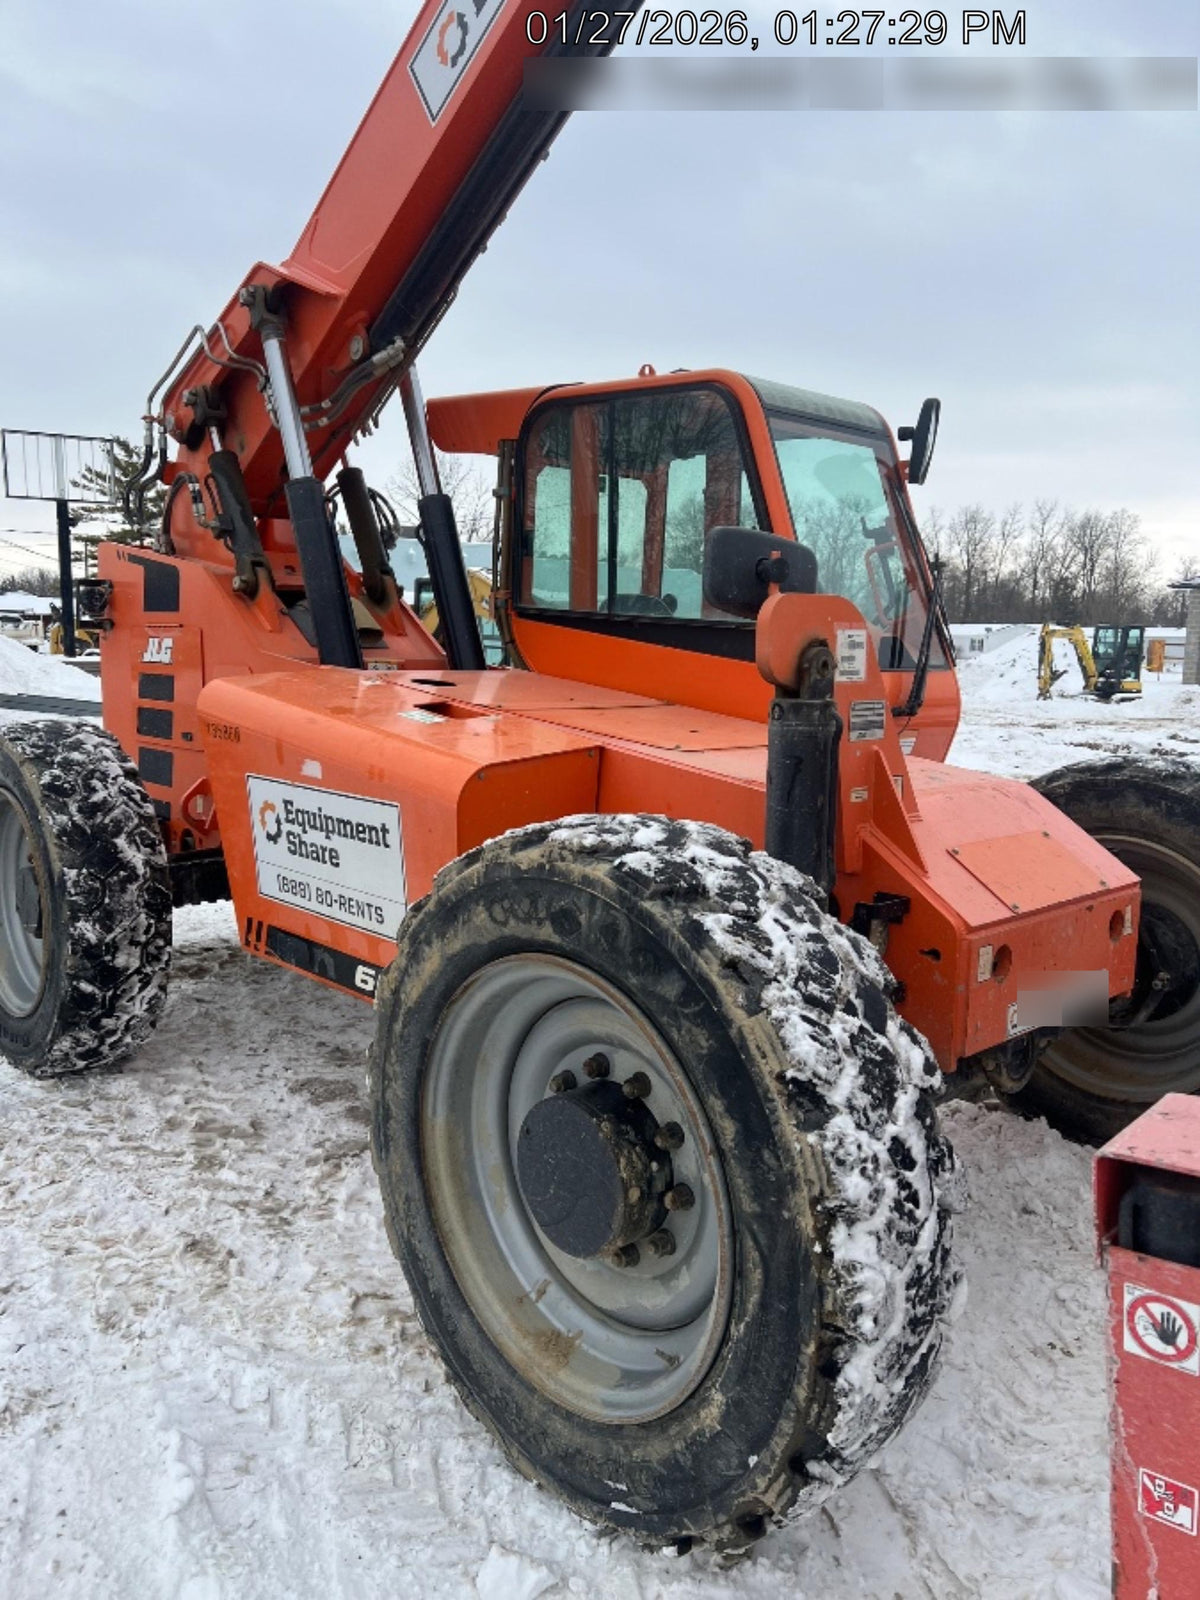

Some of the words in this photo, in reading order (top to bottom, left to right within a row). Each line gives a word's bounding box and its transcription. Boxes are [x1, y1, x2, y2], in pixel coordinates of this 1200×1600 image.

[142, 637, 173, 664] JLG
[282, 799, 390, 849] Equipment
[286, 830, 340, 868] Share
[276, 873, 312, 902] (888)
[316, 886, 385, 925] 80-RENTS
